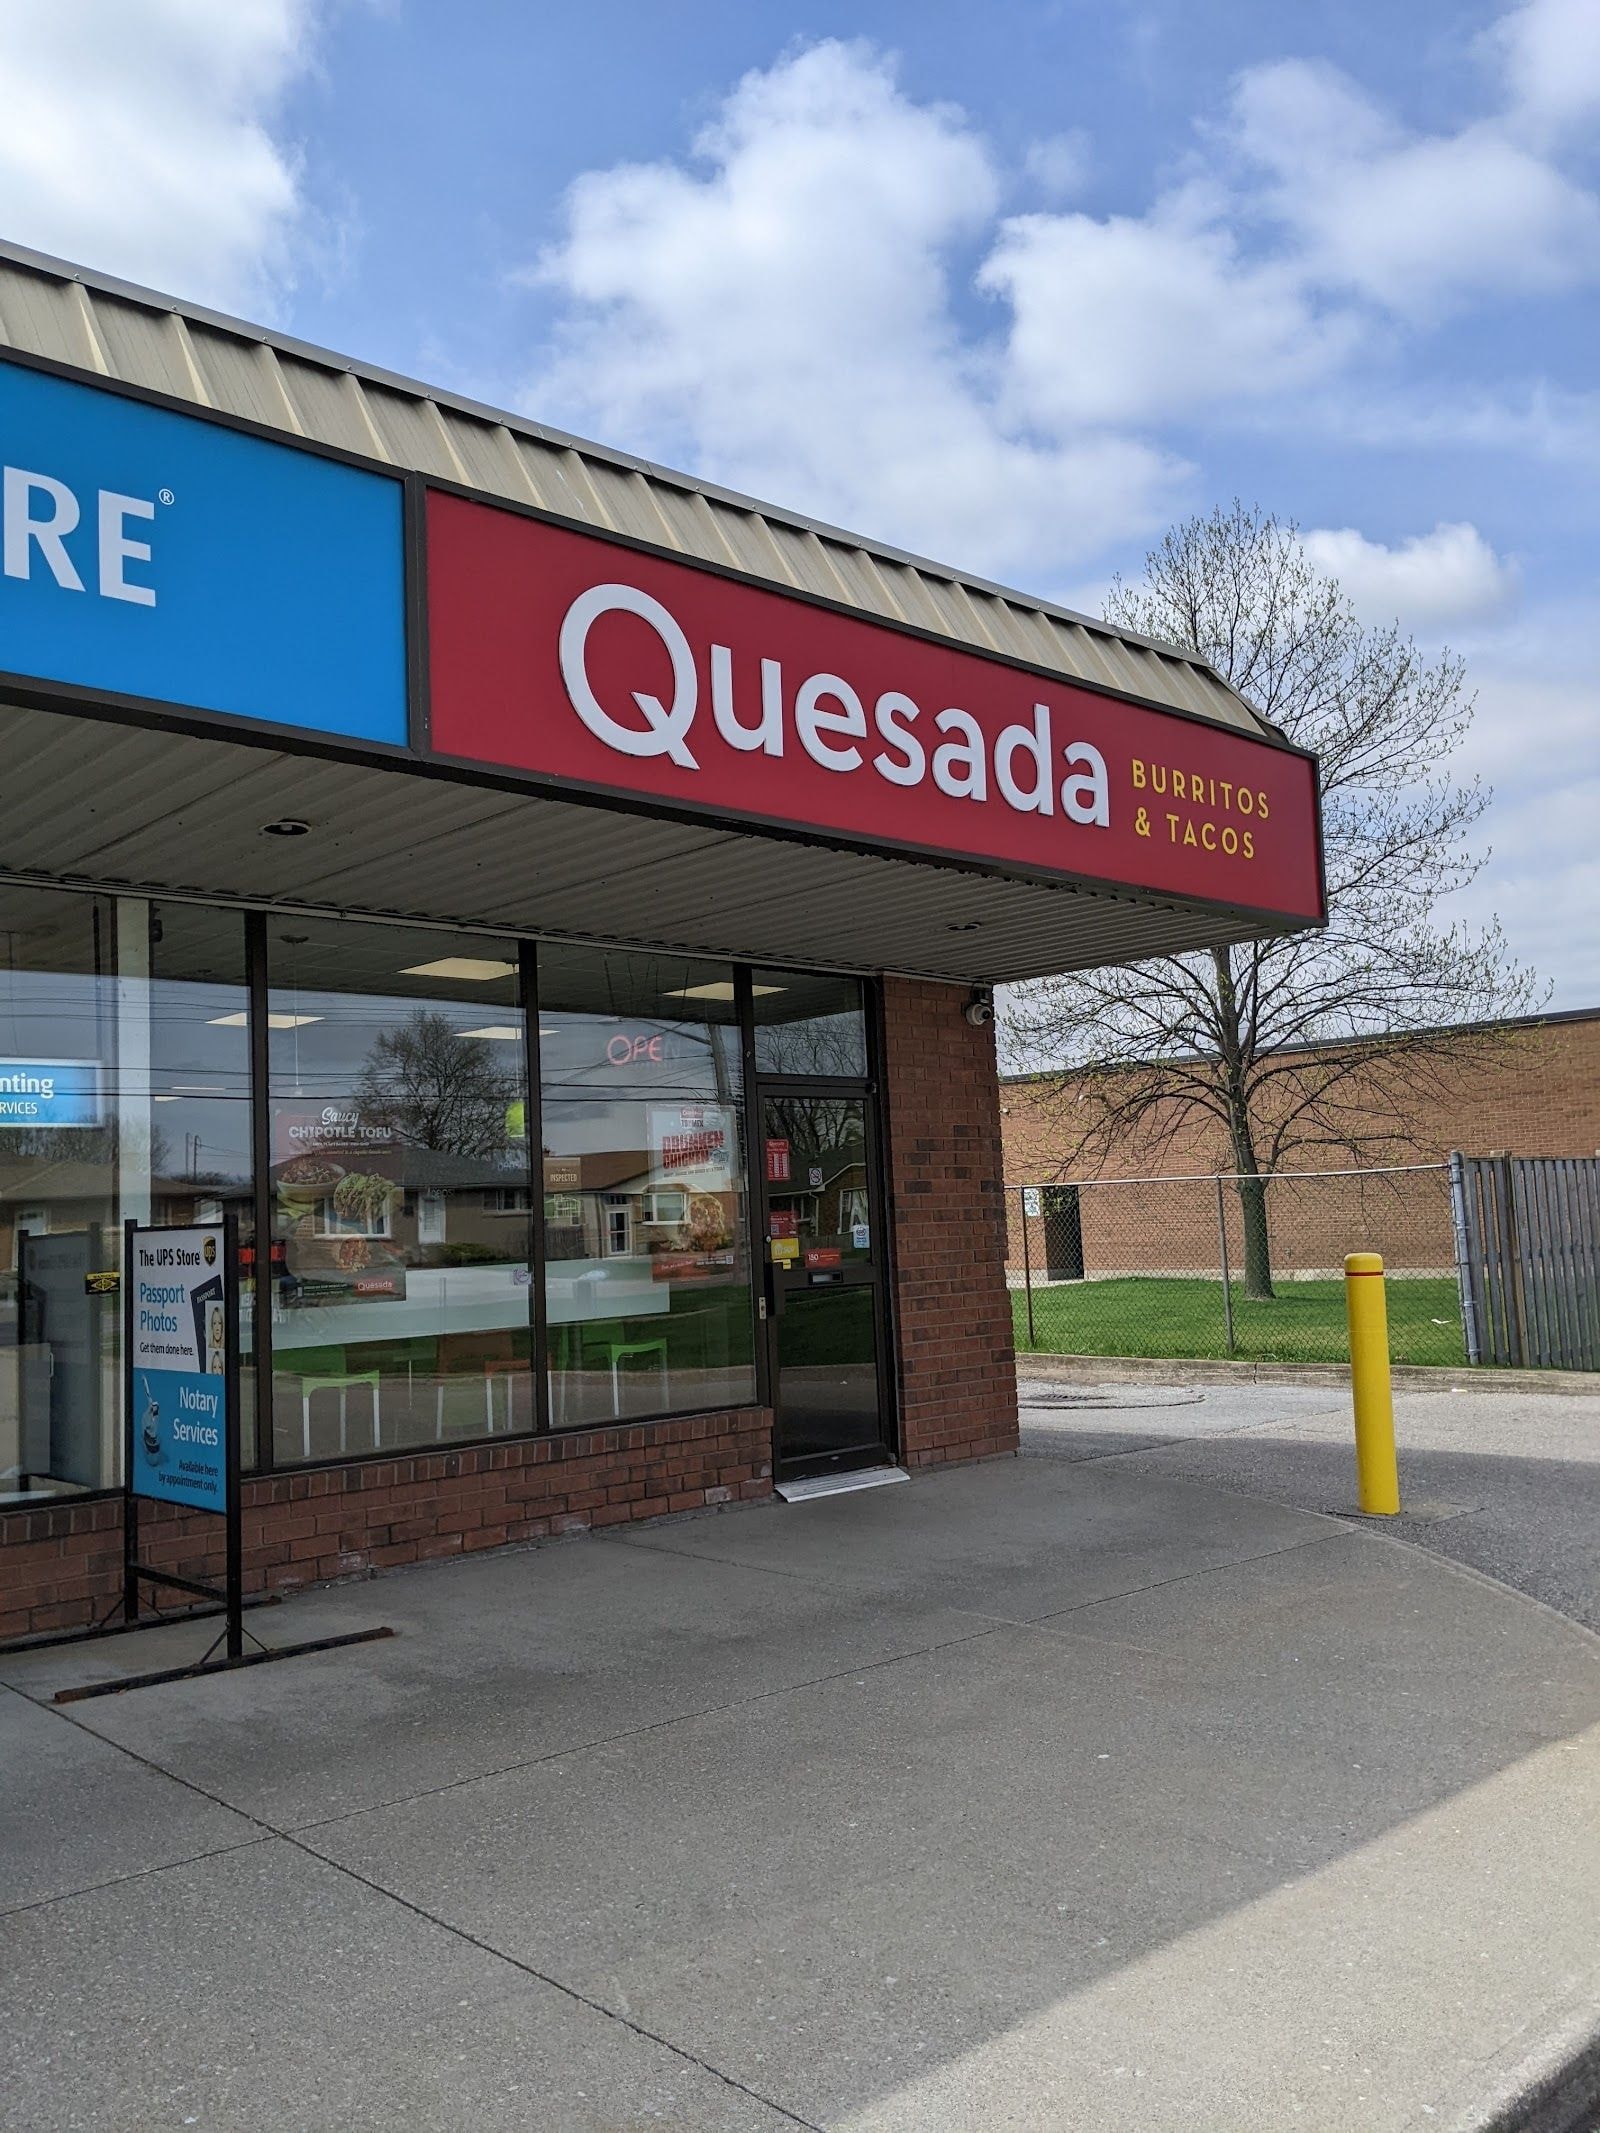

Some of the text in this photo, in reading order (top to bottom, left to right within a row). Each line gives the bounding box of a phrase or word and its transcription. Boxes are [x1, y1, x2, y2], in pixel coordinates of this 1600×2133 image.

[558, 583, 1110, 828] Quesada
[1132, 758, 1269, 819] BURRITOS
[1135, 806, 1254, 859] & TACOS
[0, 1072, 54, 1099] nting
[0, 1101, 38, 1115] RVICES
[321, 1106, 359, 1130] Saucy
[289, 1126, 392, 1139] CHIPOTLE TOFU
[139, 1248, 200, 1267] The UPS Store
[140, 1282, 185, 1309] Passport
[140, 1310, 177, 1332] Photos
[139, 1341, 149, 1353] Get
[150, 1342, 165, 1354] them
[165, 1343, 180, 1355] done
[179, 1386, 219, 1418] Notary
[173, 1417, 219, 1446] Services
[178, 1459, 219, 1477] Available here
[158, 1471, 167, 1486] by
[167, 1474, 203, 1490] appointment
